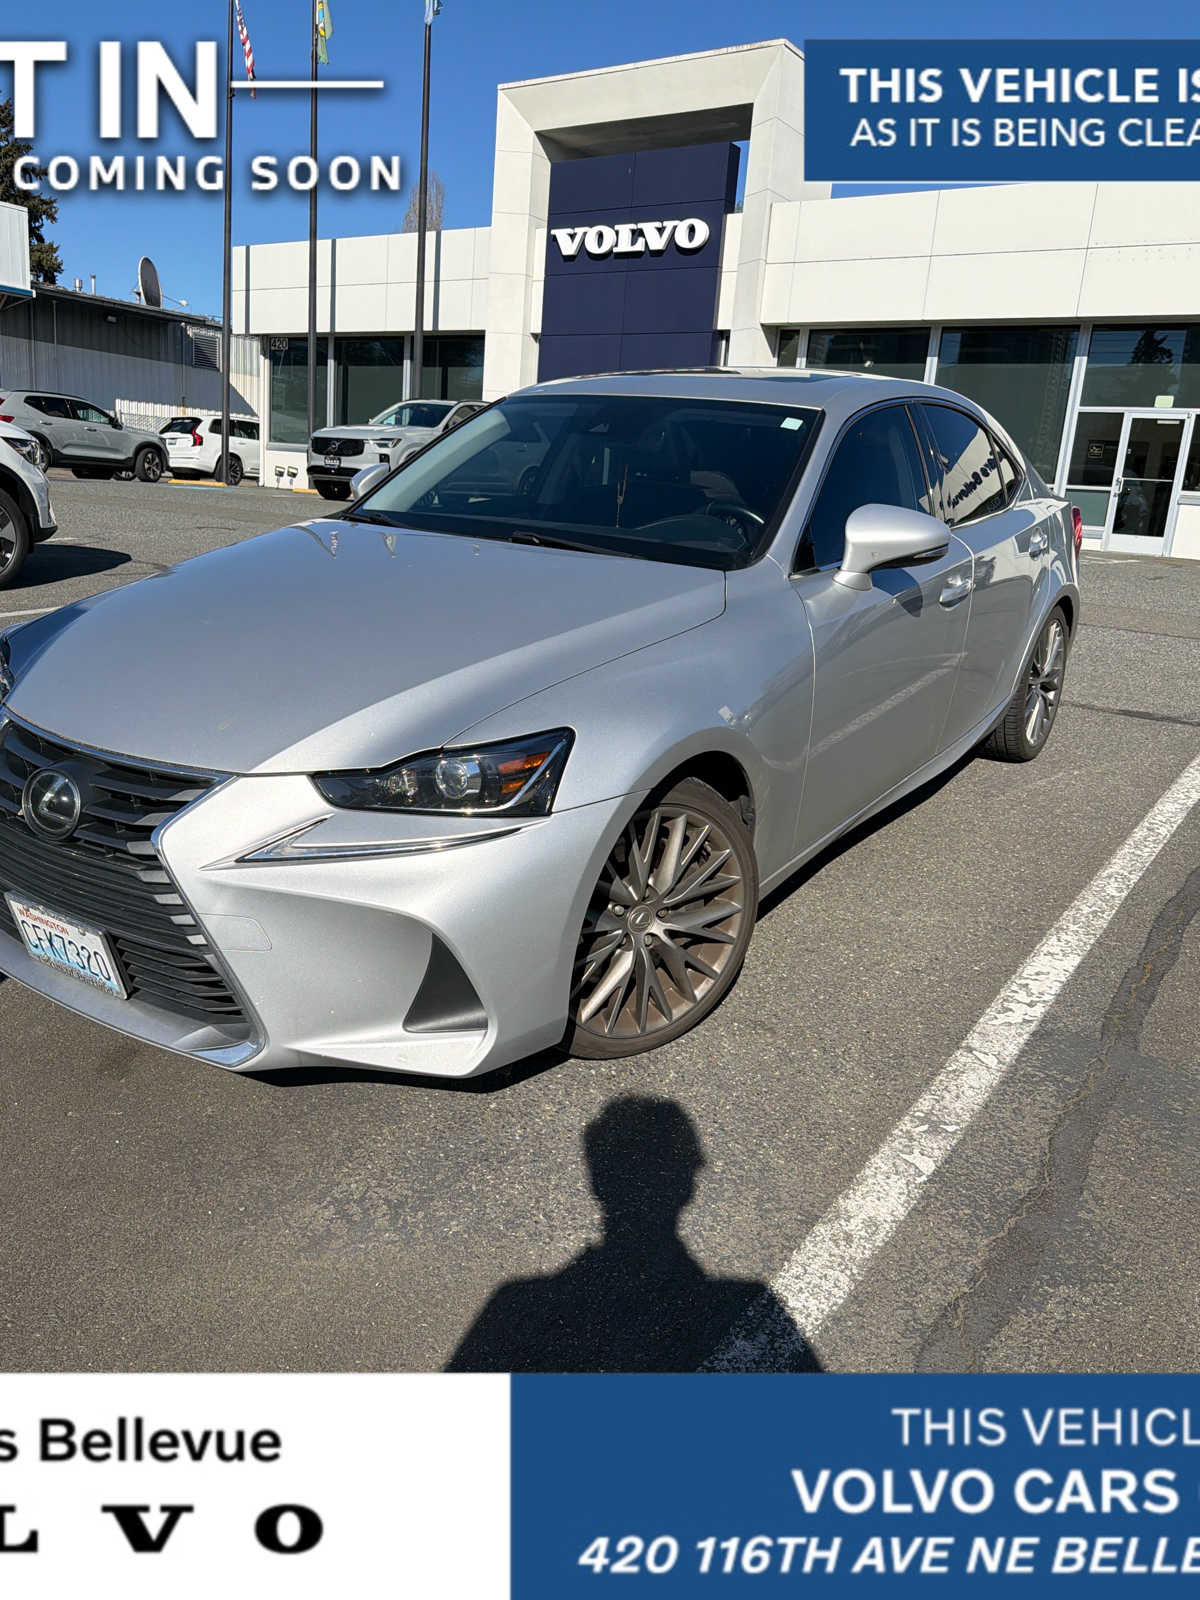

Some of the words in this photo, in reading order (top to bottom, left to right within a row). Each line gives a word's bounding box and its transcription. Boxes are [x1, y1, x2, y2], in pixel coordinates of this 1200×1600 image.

[550, 218, 710, 257] VOLVO
[271, 338, 287, 350] 420
[20, 919, 112, 982] CFK7320
